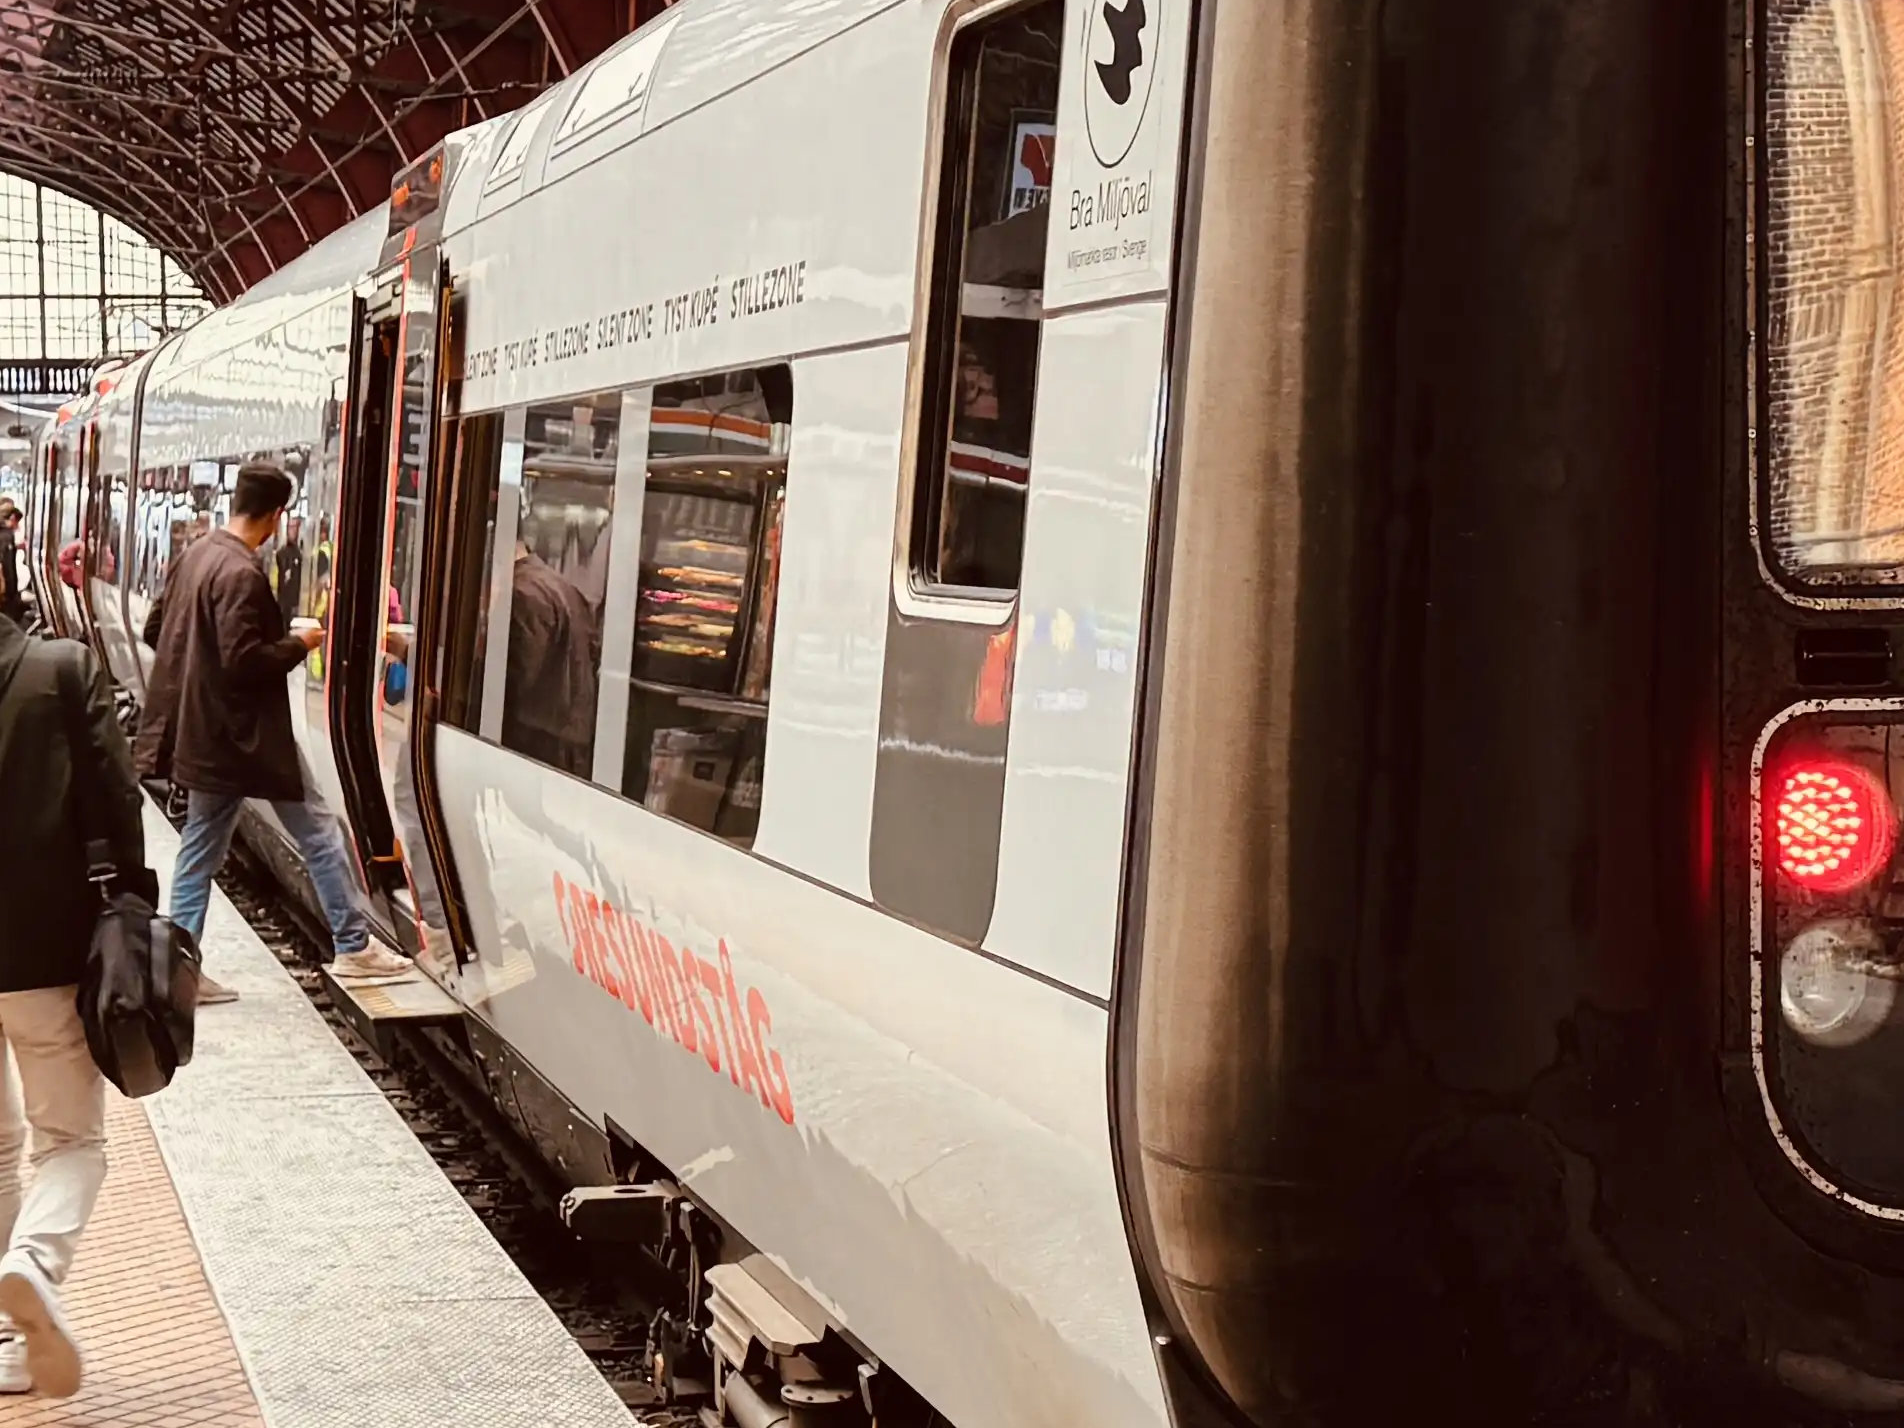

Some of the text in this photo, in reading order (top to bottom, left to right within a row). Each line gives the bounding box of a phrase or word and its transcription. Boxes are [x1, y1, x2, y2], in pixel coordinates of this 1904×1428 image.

[1070, 189, 1093, 230] Bra
[1096, 169, 1153, 232] Miljöval
[597, 311, 626, 349] SILENT
[627, 304, 653, 344] ZONE
[664, 294, 689, 336] TYST
[690, 274, 720, 328] KUPÉ
[730, 260, 807, 319] STILLEZONE
